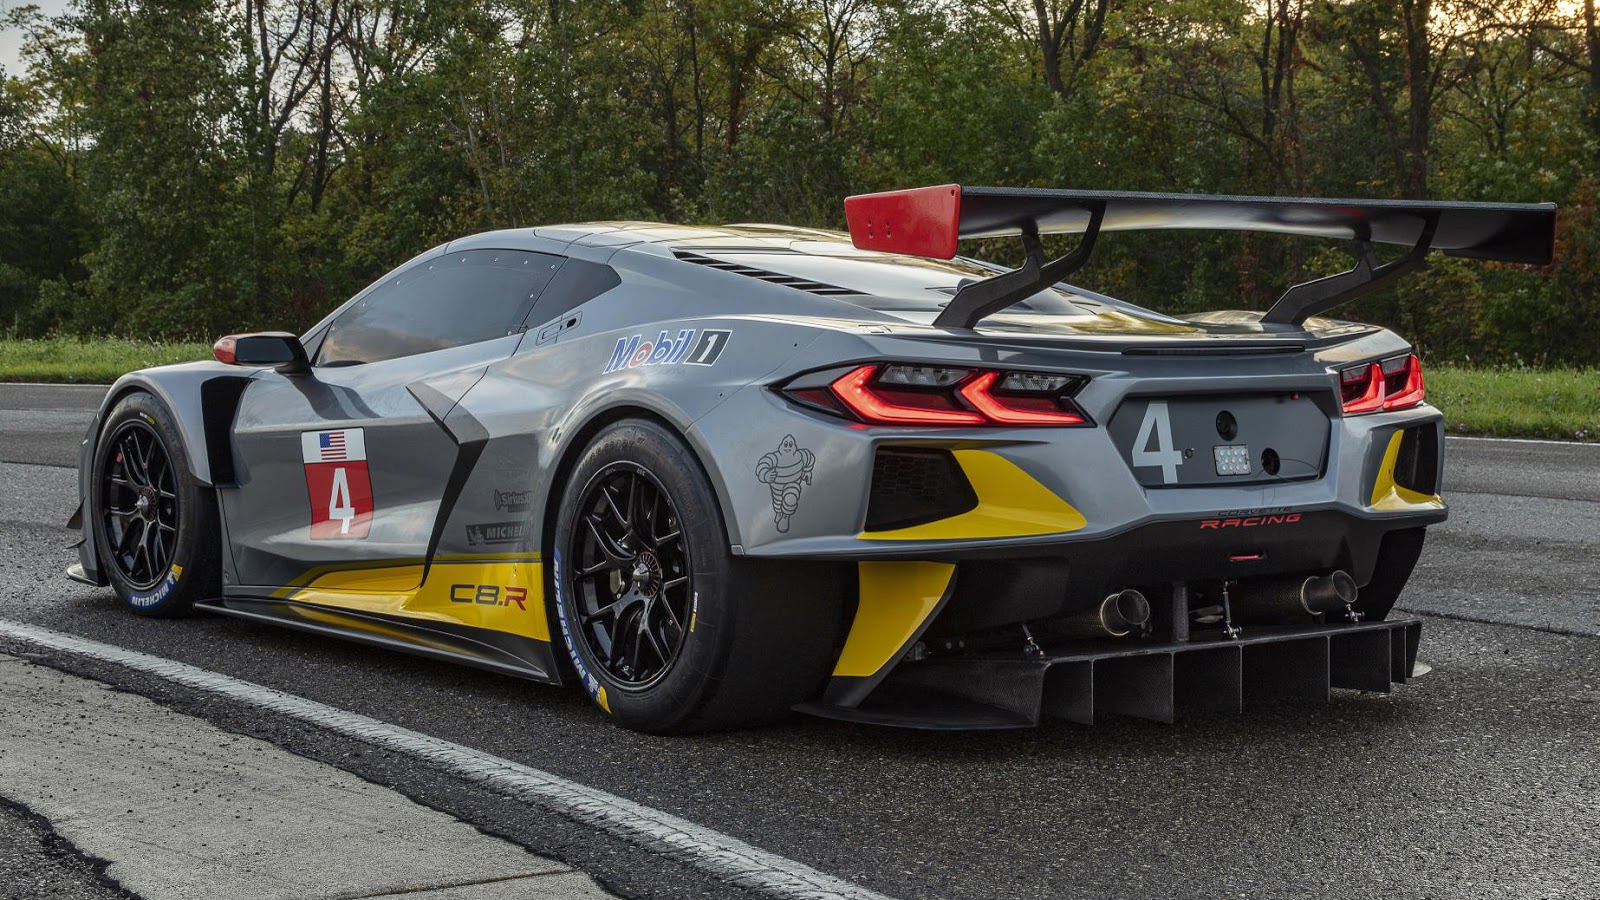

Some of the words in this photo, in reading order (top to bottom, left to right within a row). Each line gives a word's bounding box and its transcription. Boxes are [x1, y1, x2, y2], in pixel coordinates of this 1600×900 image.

[602, 328, 697, 375] Mobil
[1132, 401, 1183, 484] 4
[329, 468, 355, 533] 4
[1200, 513, 1302, 529] RACING
[131, 582, 170, 607] MICHELIN
[450, 584, 527, 610] C8.R
